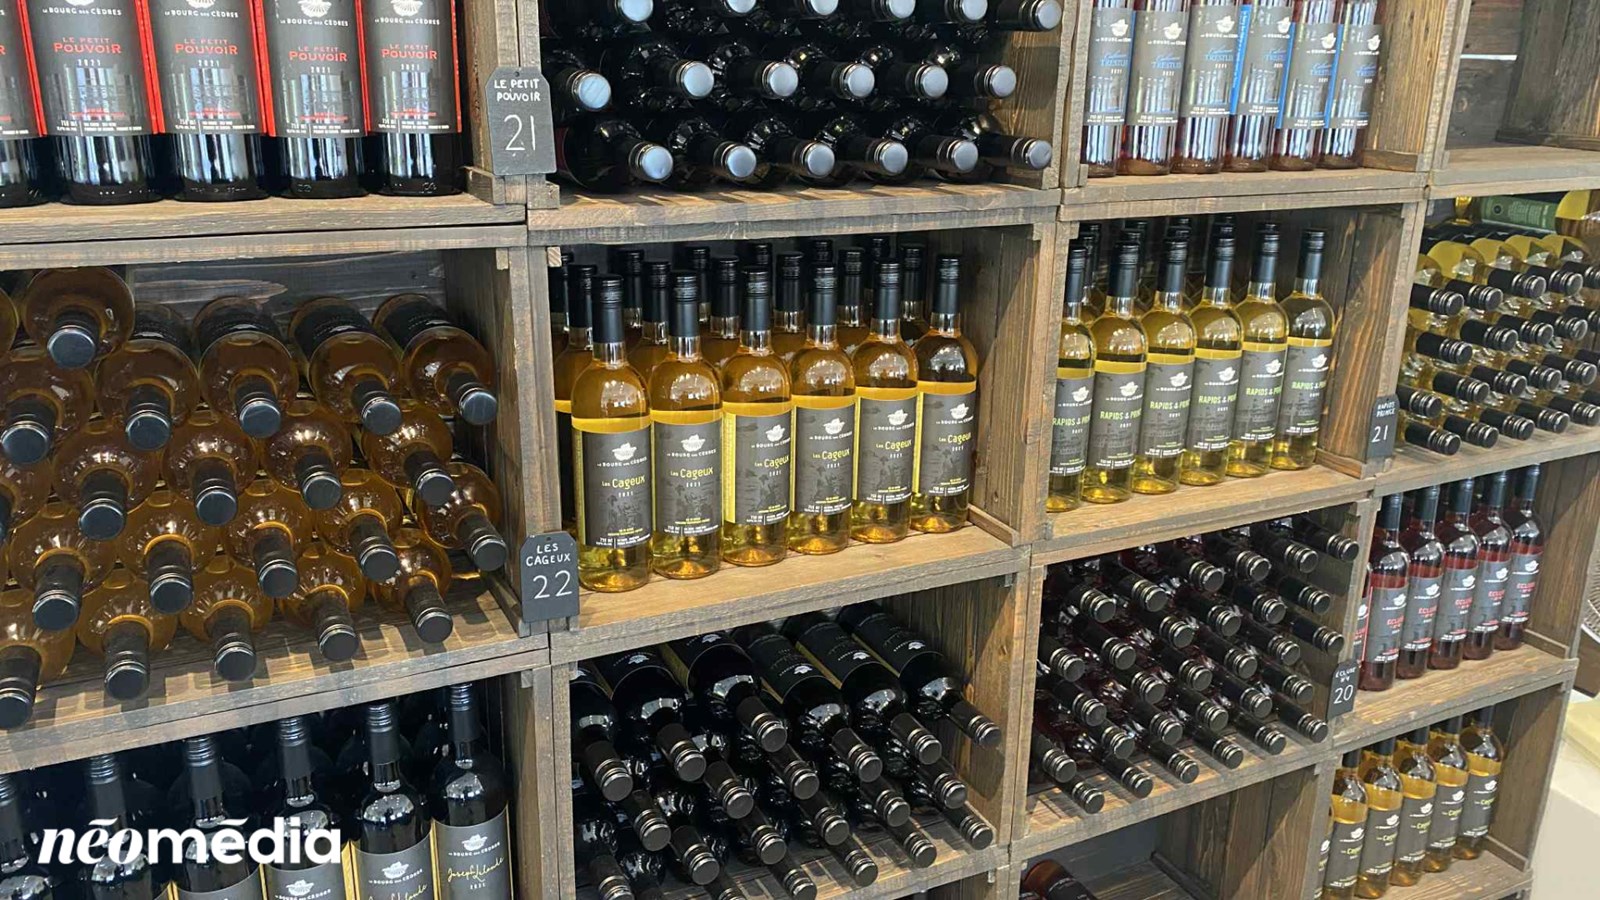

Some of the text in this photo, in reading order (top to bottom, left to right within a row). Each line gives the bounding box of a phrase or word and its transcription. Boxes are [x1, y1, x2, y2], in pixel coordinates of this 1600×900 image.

[53, 42, 122, 54] POUVOIR
[175, 43, 238, 55] POUVOIR
[381, 48, 438, 60] POUVOIR
[288, 50, 348, 62] POUVOIR
[494, 79, 540, 89] LE PETIT
[496, 92, 541, 102] POUVOIR
[504, 114, 536, 151] 21
[1246, 387, 1268, 396] RAPIDS
[1291, 381, 1314, 390] RAPIDS
[1150, 401, 1173, 410] RAPIDS
[1199, 395, 1222, 404] RAPIDS
[1052, 417, 1075, 426] RAPIDS
[1100, 411, 1124, 420] RAPIDS
[1371, 425, 1388, 442] 21
[680, 467, 713, 480] Cageux
[612, 475, 646, 490] Cageux
[537, 543, 559, 554] LES
[526, 553, 571, 567] CAGEUX
[533, 570, 573, 599] 22
[1333, 685, 1353, 704] 20
